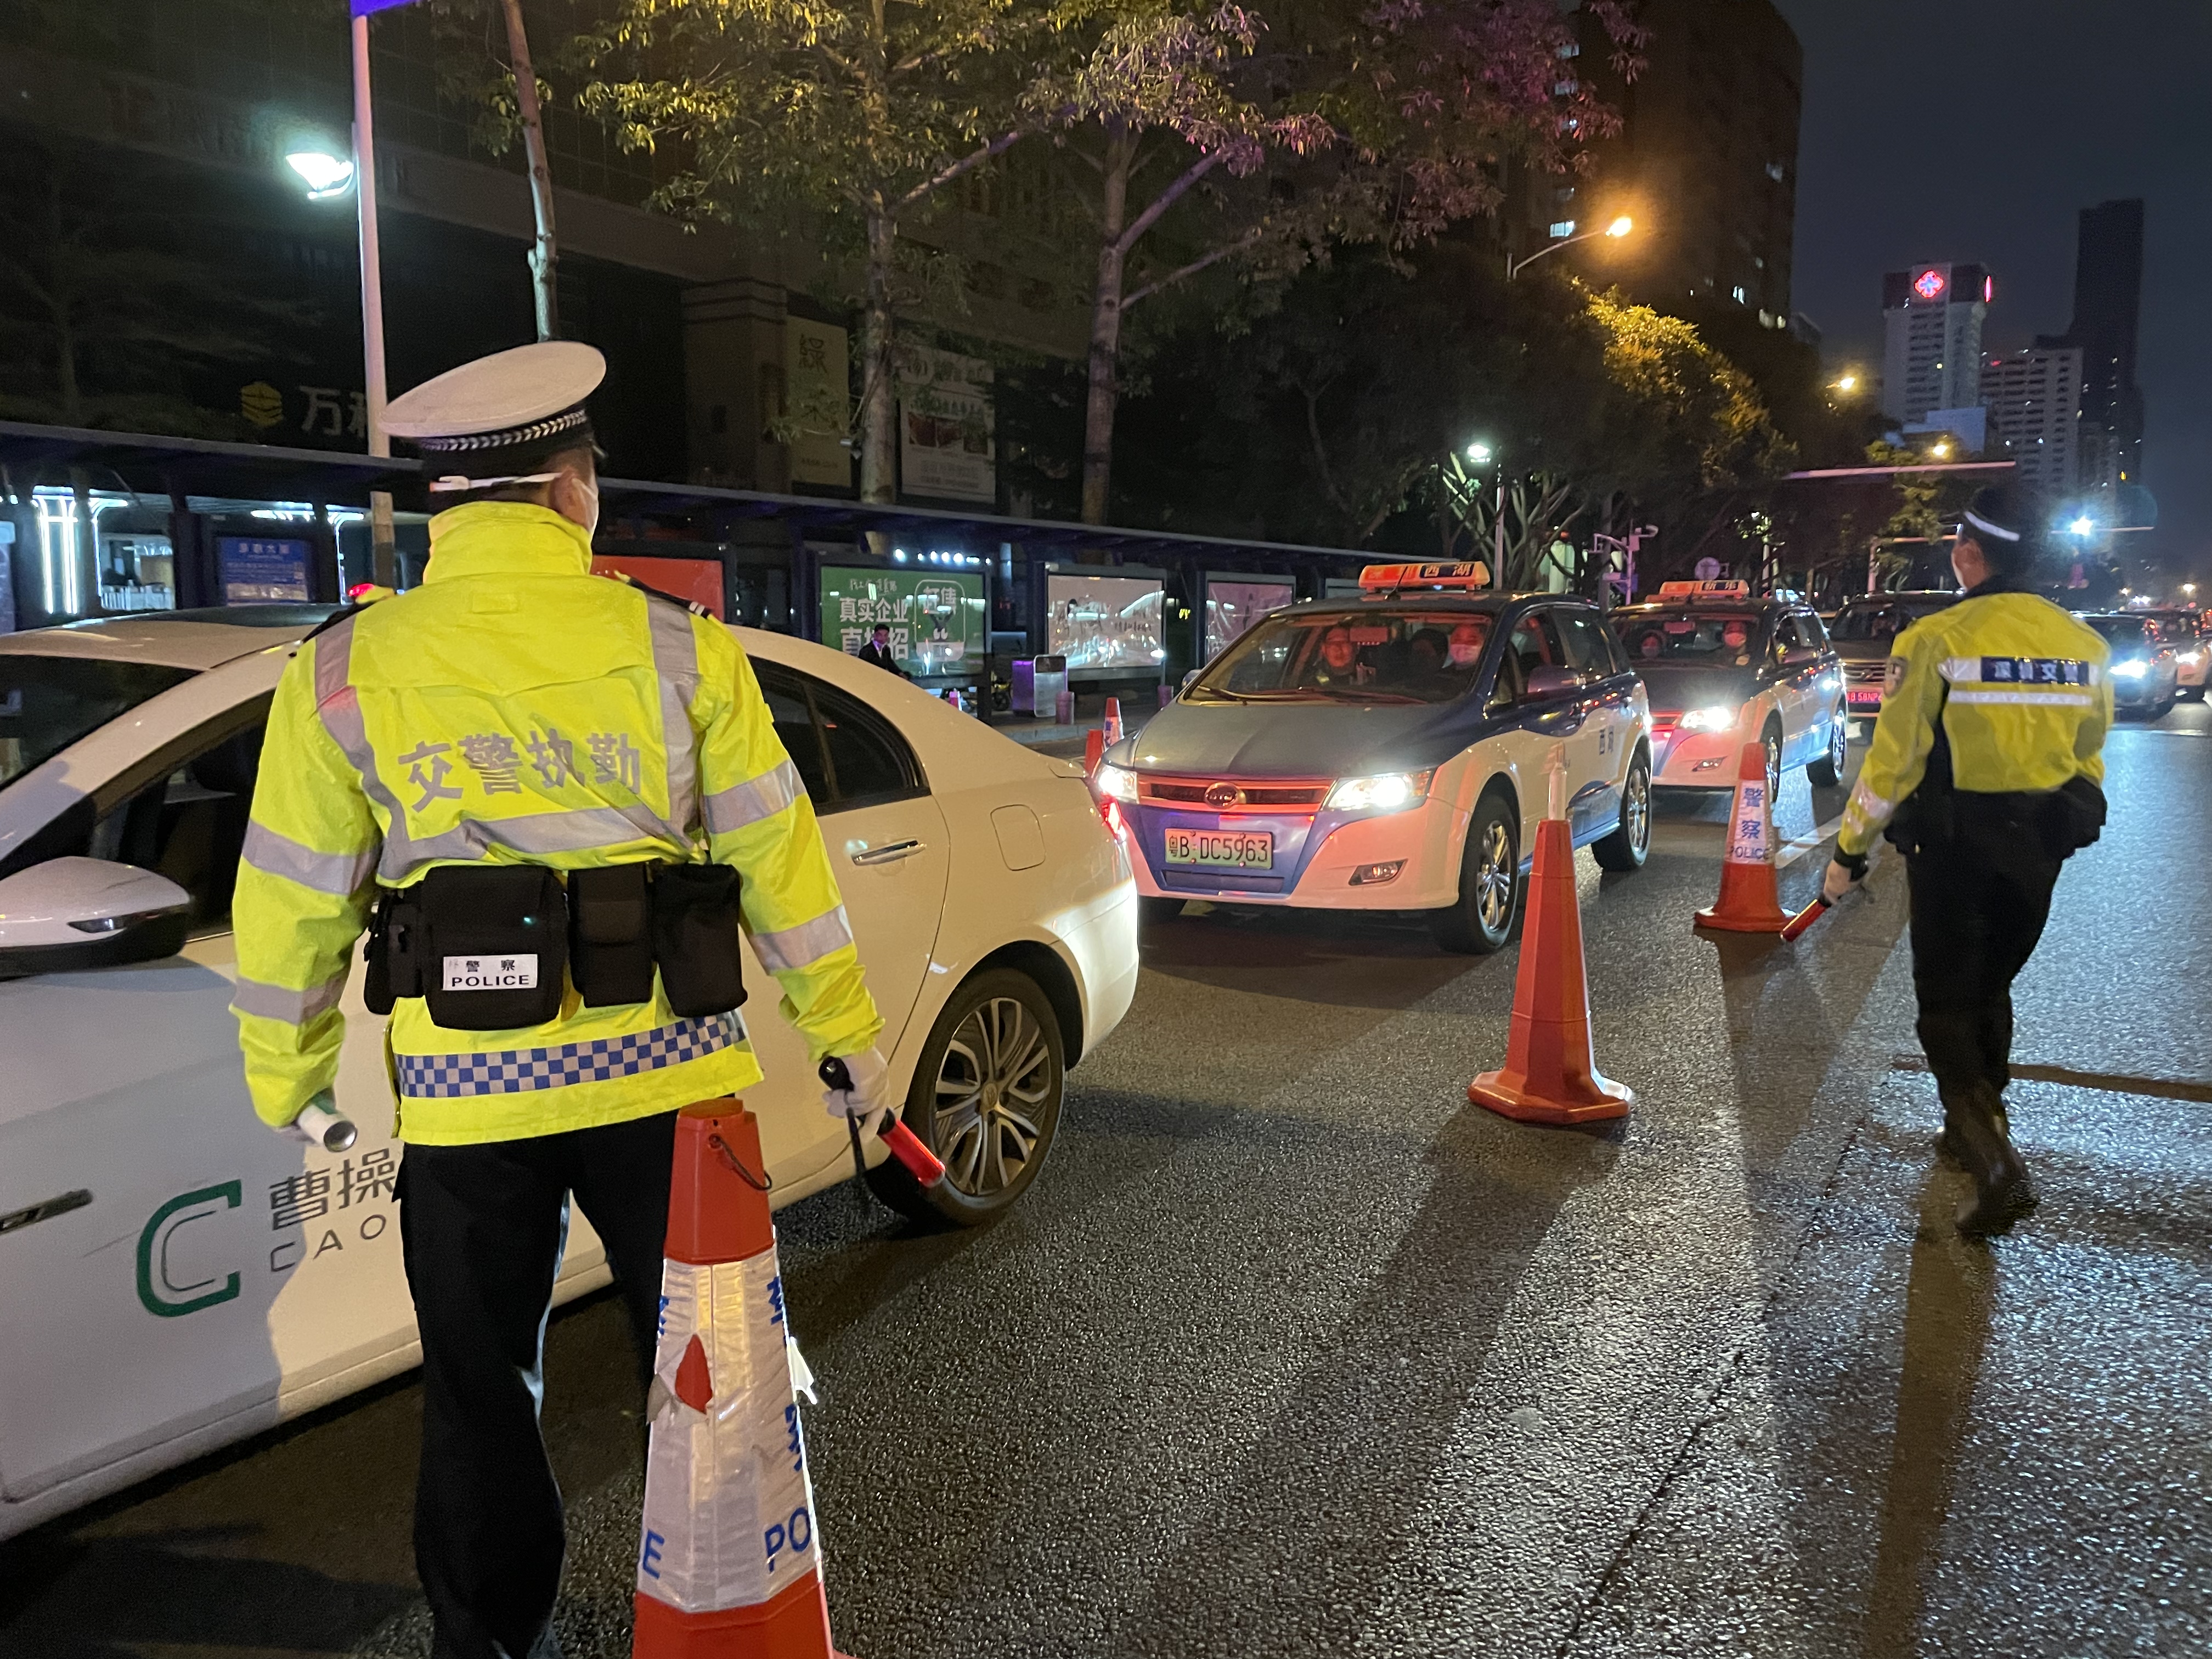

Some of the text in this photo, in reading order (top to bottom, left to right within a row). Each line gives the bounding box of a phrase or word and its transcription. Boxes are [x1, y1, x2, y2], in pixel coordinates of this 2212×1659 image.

[839, 597, 909, 623] 真实企业
[398, 727, 641, 812] 交警执勤
[1743, 787, 1764, 839] 警察
[452, 974, 529, 987] POLICE
[268, 1148, 396, 1231] 曹操
